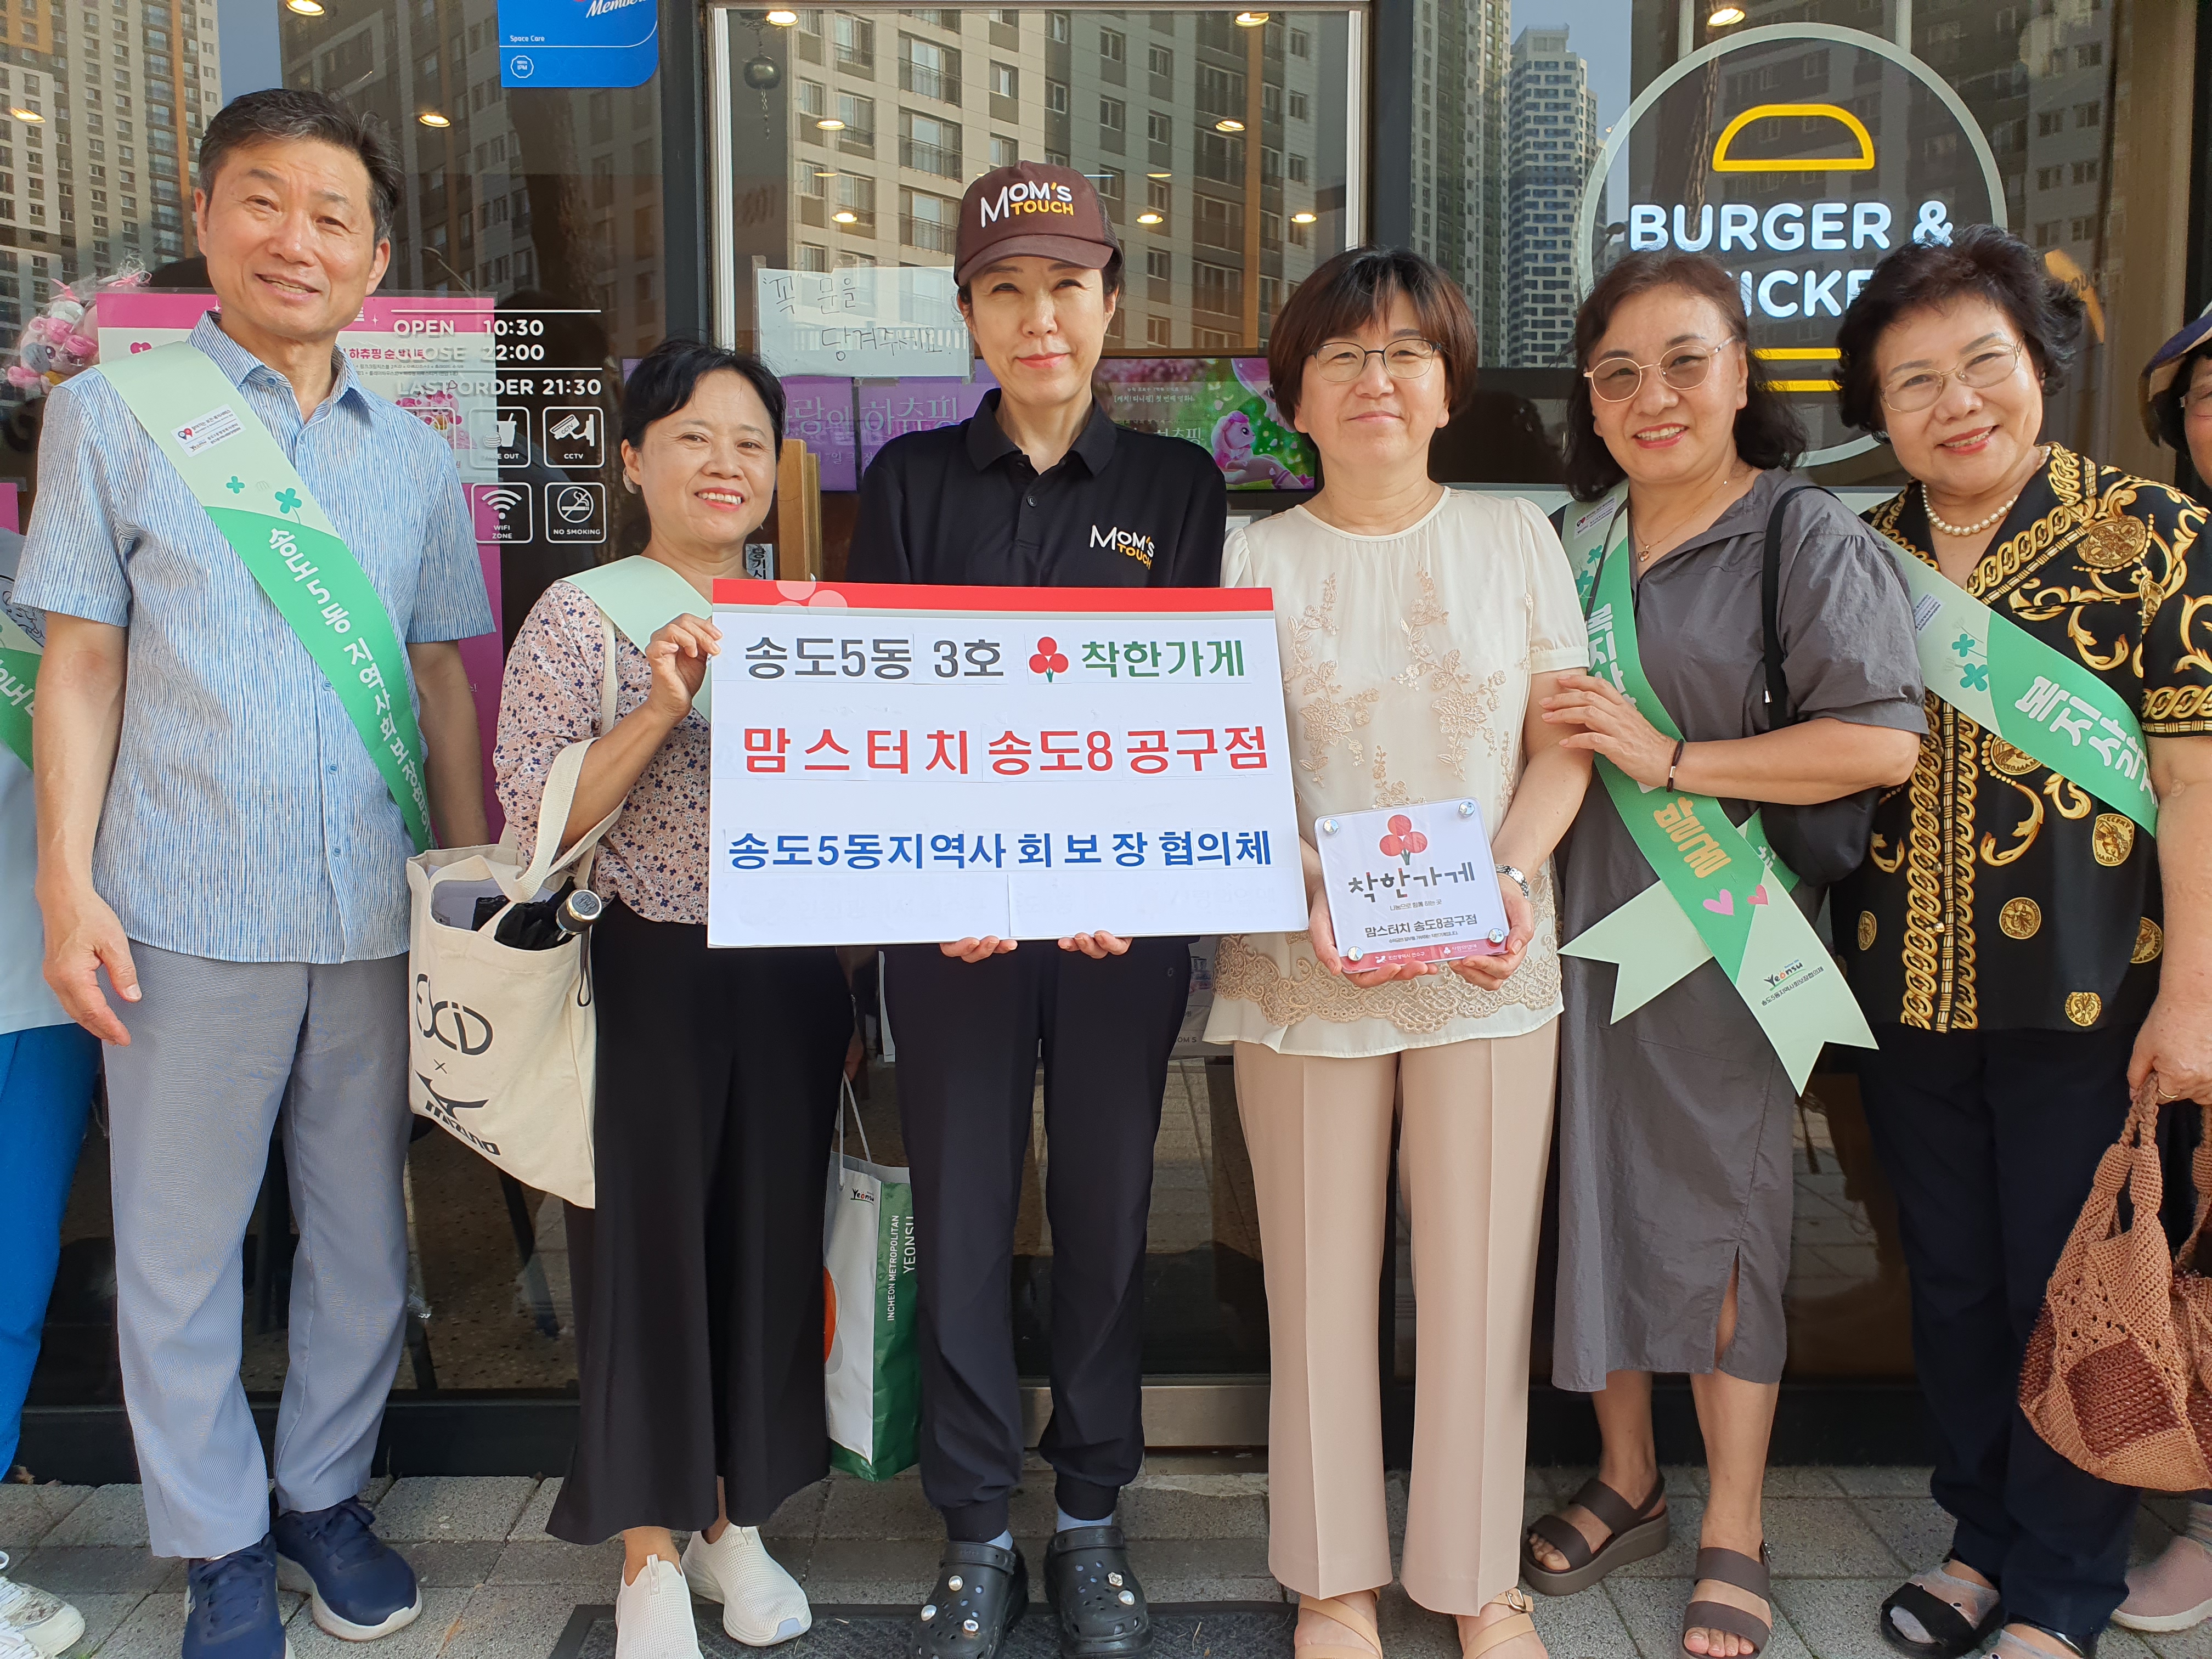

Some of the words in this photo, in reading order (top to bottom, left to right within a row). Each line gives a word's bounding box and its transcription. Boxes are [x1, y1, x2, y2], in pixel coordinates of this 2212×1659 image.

[980, 180, 1073, 228] MOM'S
[1011, 200, 1074, 216] TOUCH
[1630, 202, 1892, 252] BURGER
[1913, 200, 1954, 249] &
[817, 277, 856, 314] 문을
[393, 320, 455, 336] OPEN
[483, 319, 544, 336] 10:30
[349, 348, 381, 359] 하츄핑
[395, 346, 465, 361] CLOSE
[481, 345, 545, 361] 22:00
[397, 380, 450, 396] LAST
[456, 379, 534, 396] ORDER
[542, 379, 601, 395] 21:30
[561, 422, 574, 435] CCTV
[1090, 524, 1155, 558] MOM'S
[1117, 543, 1152, 570] TOUCH
[268, 527, 352, 634] 송도5동
[746, 637, 911, 679] 송도5동
[934, 640, 1003, 678] 3호
[1084, 642, 1243, 676] 착한가게
[1655, 798, 1730, 877] 발굴
[1348, 861, 1476, 903] 착한가게
[1365, 922, 1410, 938] 맘스터치
[1413, 913, 1477, 933] 송도8공구점
[1763, 962, 1803, 987] Yeonsu
[851, 1188, 874, 1202] Yeonsu
[888, 1215, 900, 1281] METROPOLITAN
[887, 1283, 896, 1321] INCHEON
